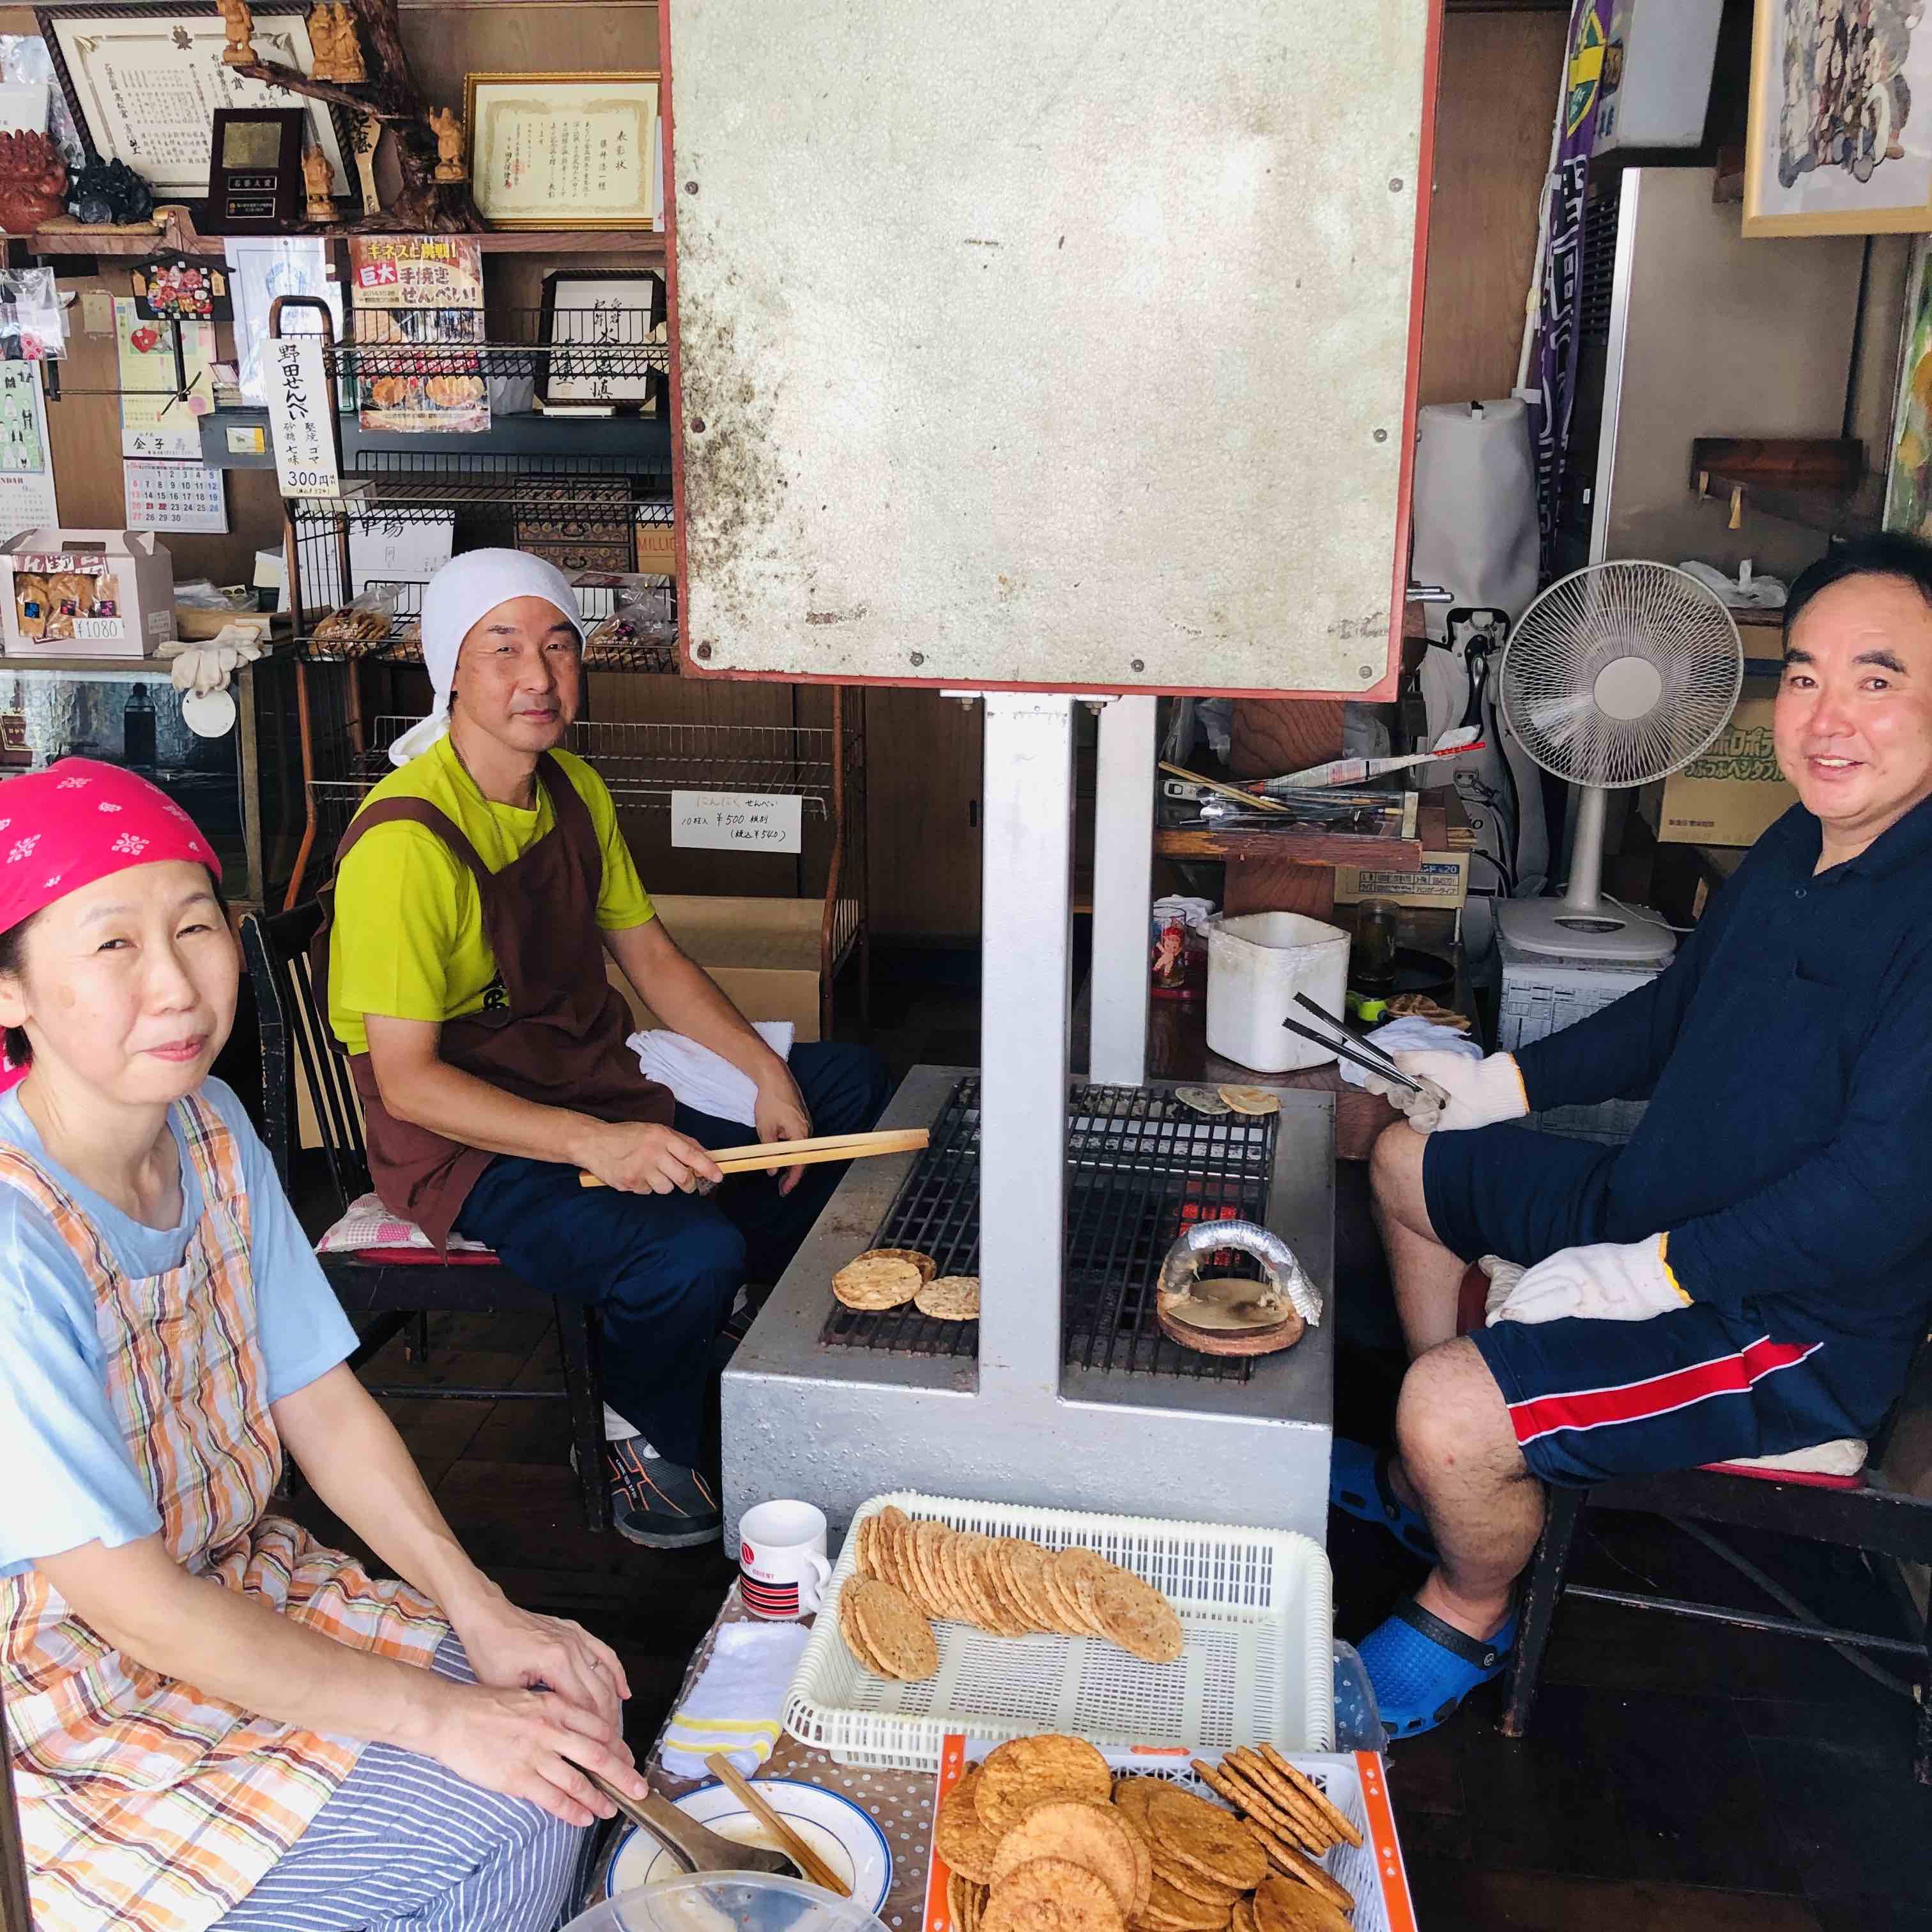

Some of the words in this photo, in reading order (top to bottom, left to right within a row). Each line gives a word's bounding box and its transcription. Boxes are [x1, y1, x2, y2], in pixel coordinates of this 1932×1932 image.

[360, 263, 396, 286] 巨大
[400, 266, 450, 285] 手焼き
[277, 344, 309, 420] 野田せんべい
[286, 445, 300, 465] 七味
[288, 471, 330, 487] 300円
[76, 619, 118, 638] ¥1080
[746, 799, 778, 808] せんべい
[716, 812, 744, 827] ¥500
